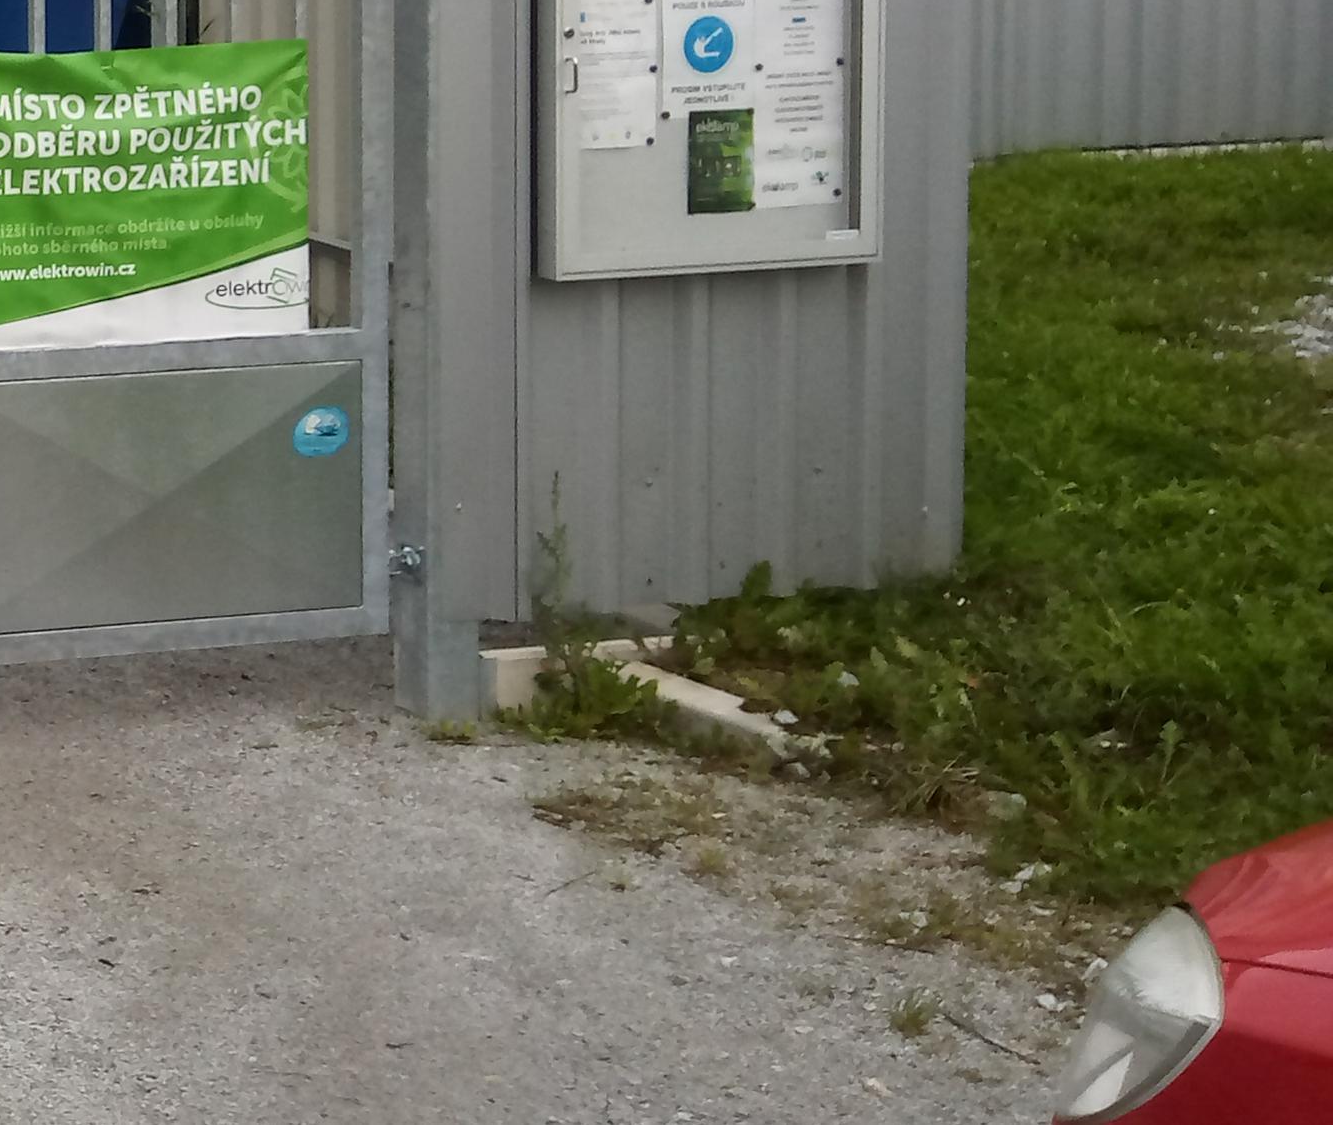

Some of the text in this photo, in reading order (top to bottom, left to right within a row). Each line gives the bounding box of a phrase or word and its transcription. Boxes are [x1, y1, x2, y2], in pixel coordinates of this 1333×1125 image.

[94, 82, 262, 120] ZPĚTNÉHO
[129, 115, 308, 156] POUŽITÝCH
[30, 221, 113, 238] informace
[117, 218, 186, 235] obdržíte
[190, 220, 200, 231] u
[204, 213, 263, 230] obsluhy
[43, 238, 119, 255] sběrného
